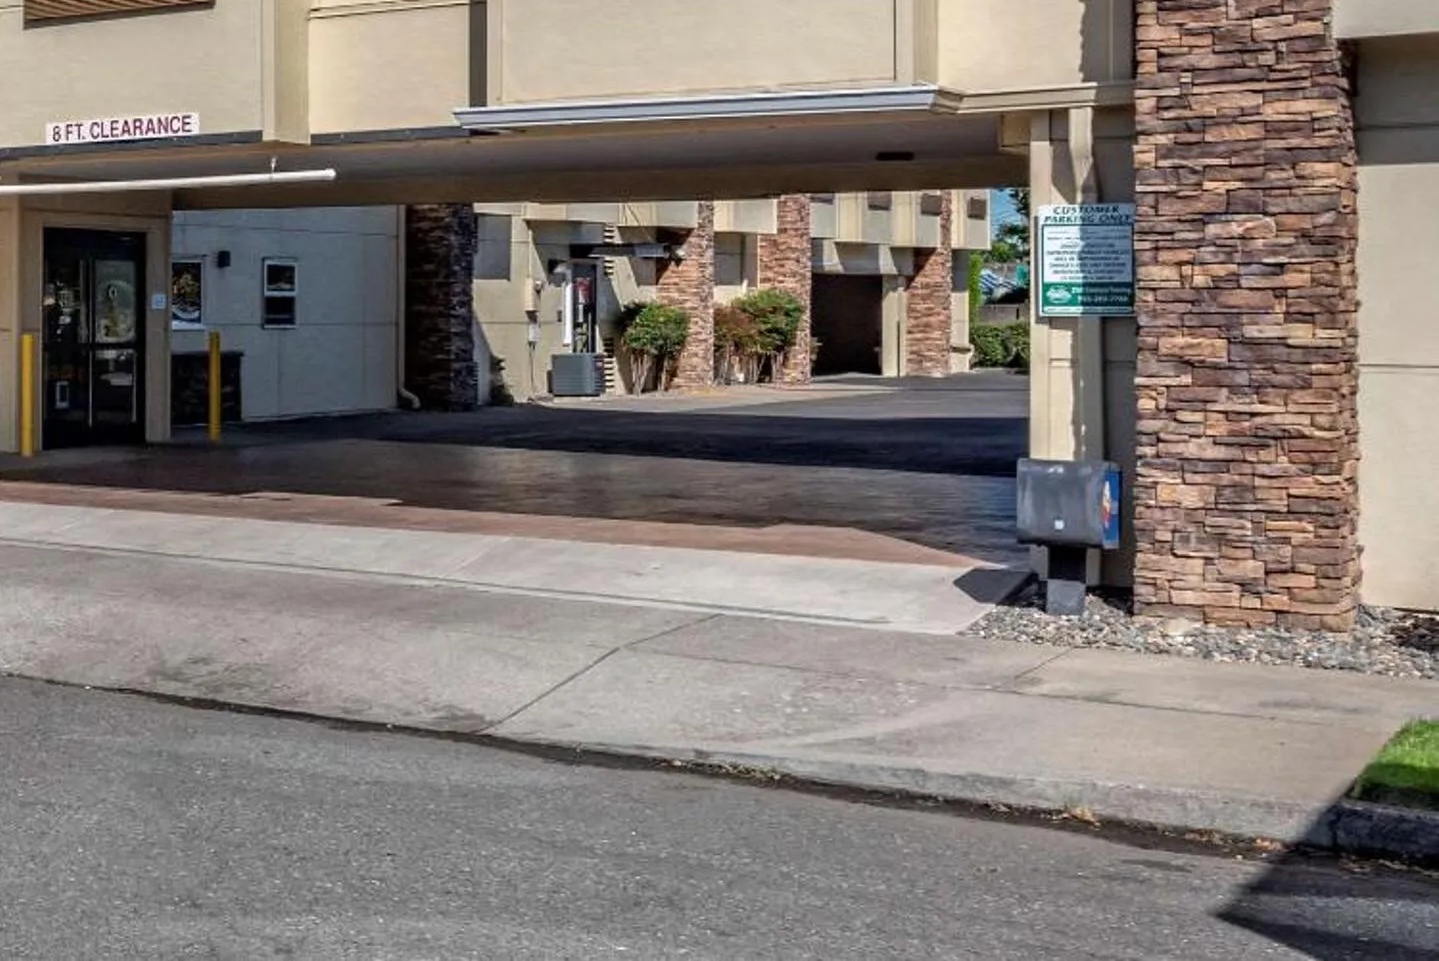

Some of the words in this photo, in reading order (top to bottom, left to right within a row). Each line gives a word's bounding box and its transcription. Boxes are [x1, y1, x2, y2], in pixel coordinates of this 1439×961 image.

[52, 125, 61, 142] 8
[65, 123, 86, 140] FT.
[89, 115, 193, 139] CLEARANCE
